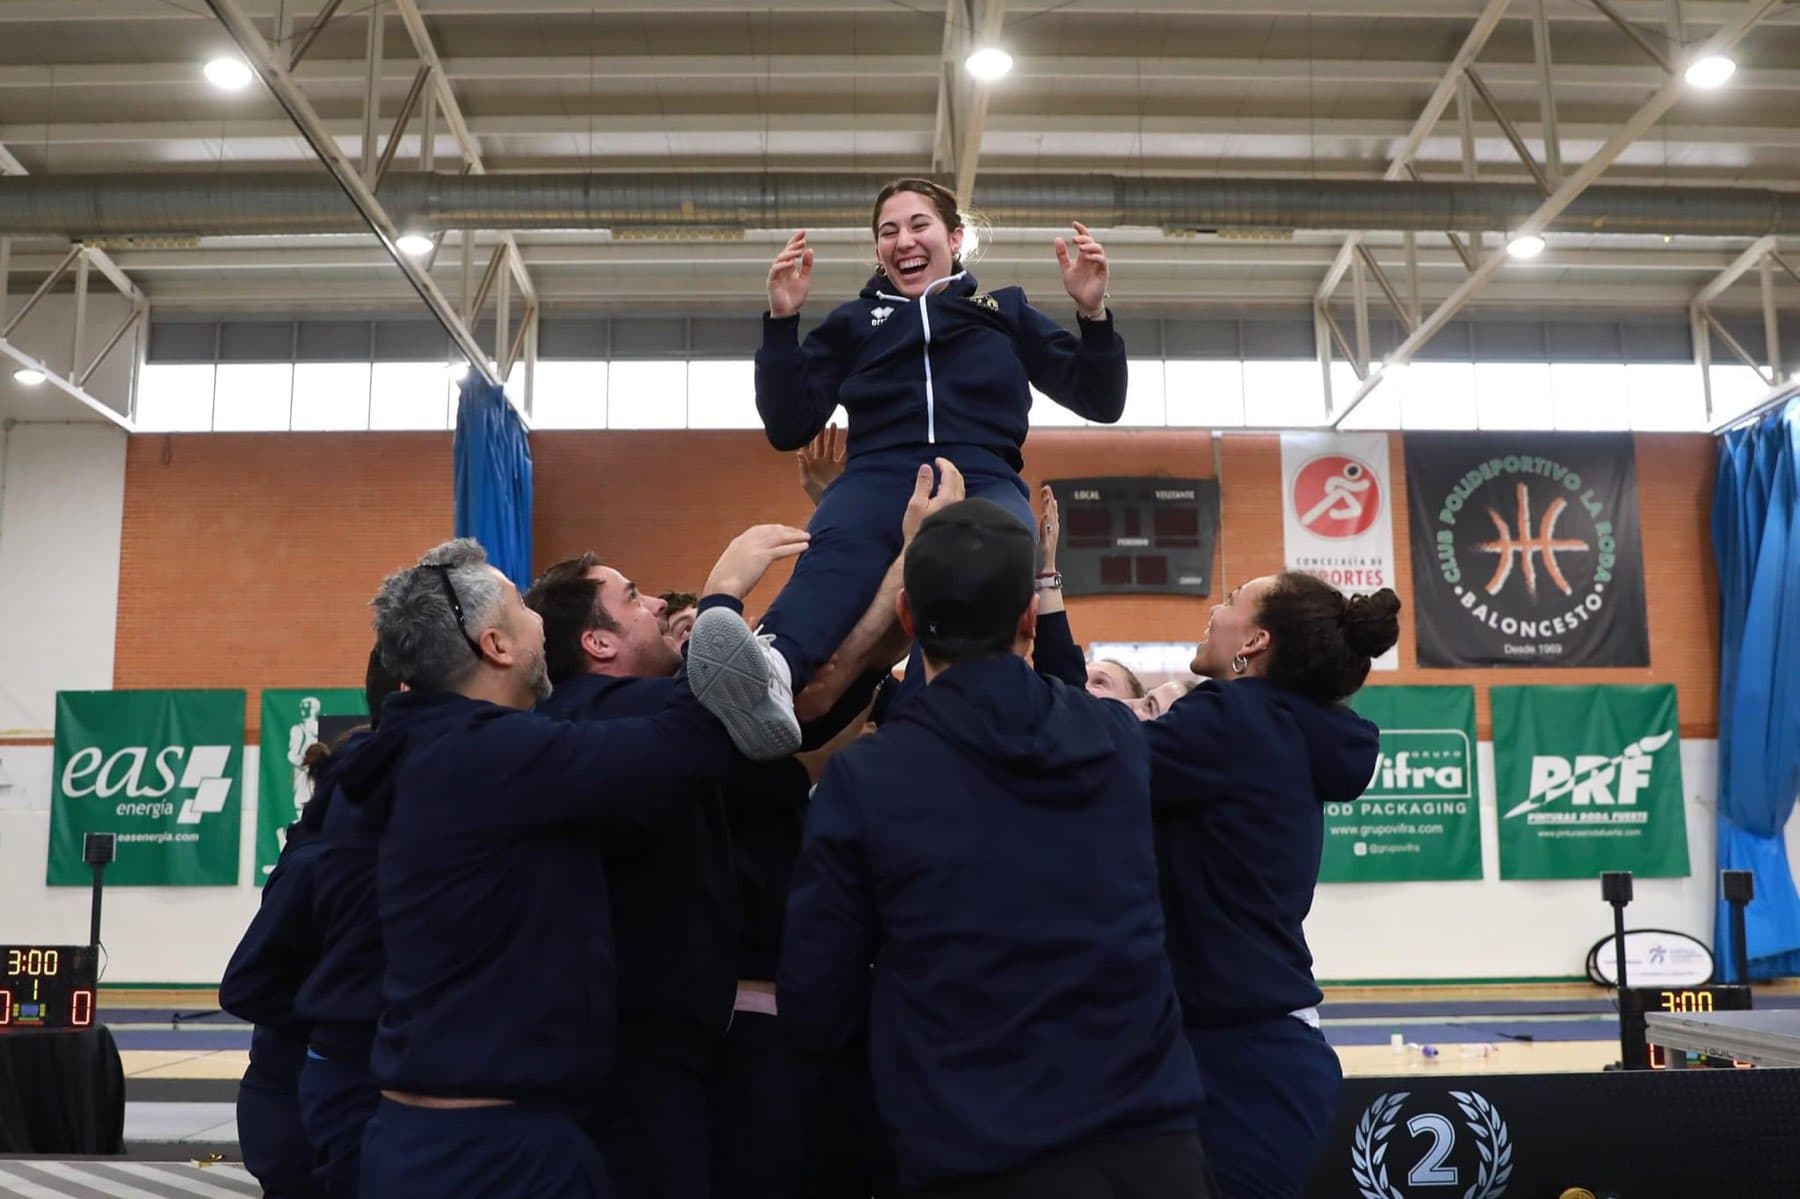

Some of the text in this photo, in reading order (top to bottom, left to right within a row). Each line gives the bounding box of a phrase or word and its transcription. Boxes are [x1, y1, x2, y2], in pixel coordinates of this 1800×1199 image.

[1074, 490, 1099, 500] LOCAL
[1437, 455, 1615, 583] CLUB POLIDEPORTIVO LA RODA
[1310, 569, 1383, 586] PORTES
[1461, 590, 1602, 638] BALONCESTO
[1504, 644, 1535, 655] Desde
[62, 746, 184, 798] eas
[1529, 755, 1653, 805] PRF
[1324, 802, 1467, 816] OD PACKAGING
[1330, 823, 1443, 837] www.grupovifra.com
[8, 949, 58, 975] 3:00
[72, 990, 91, 1025] 0
[1661, 991, 1713, 1013] 3:00
[1406, 1113, 1458, 1186] 2
